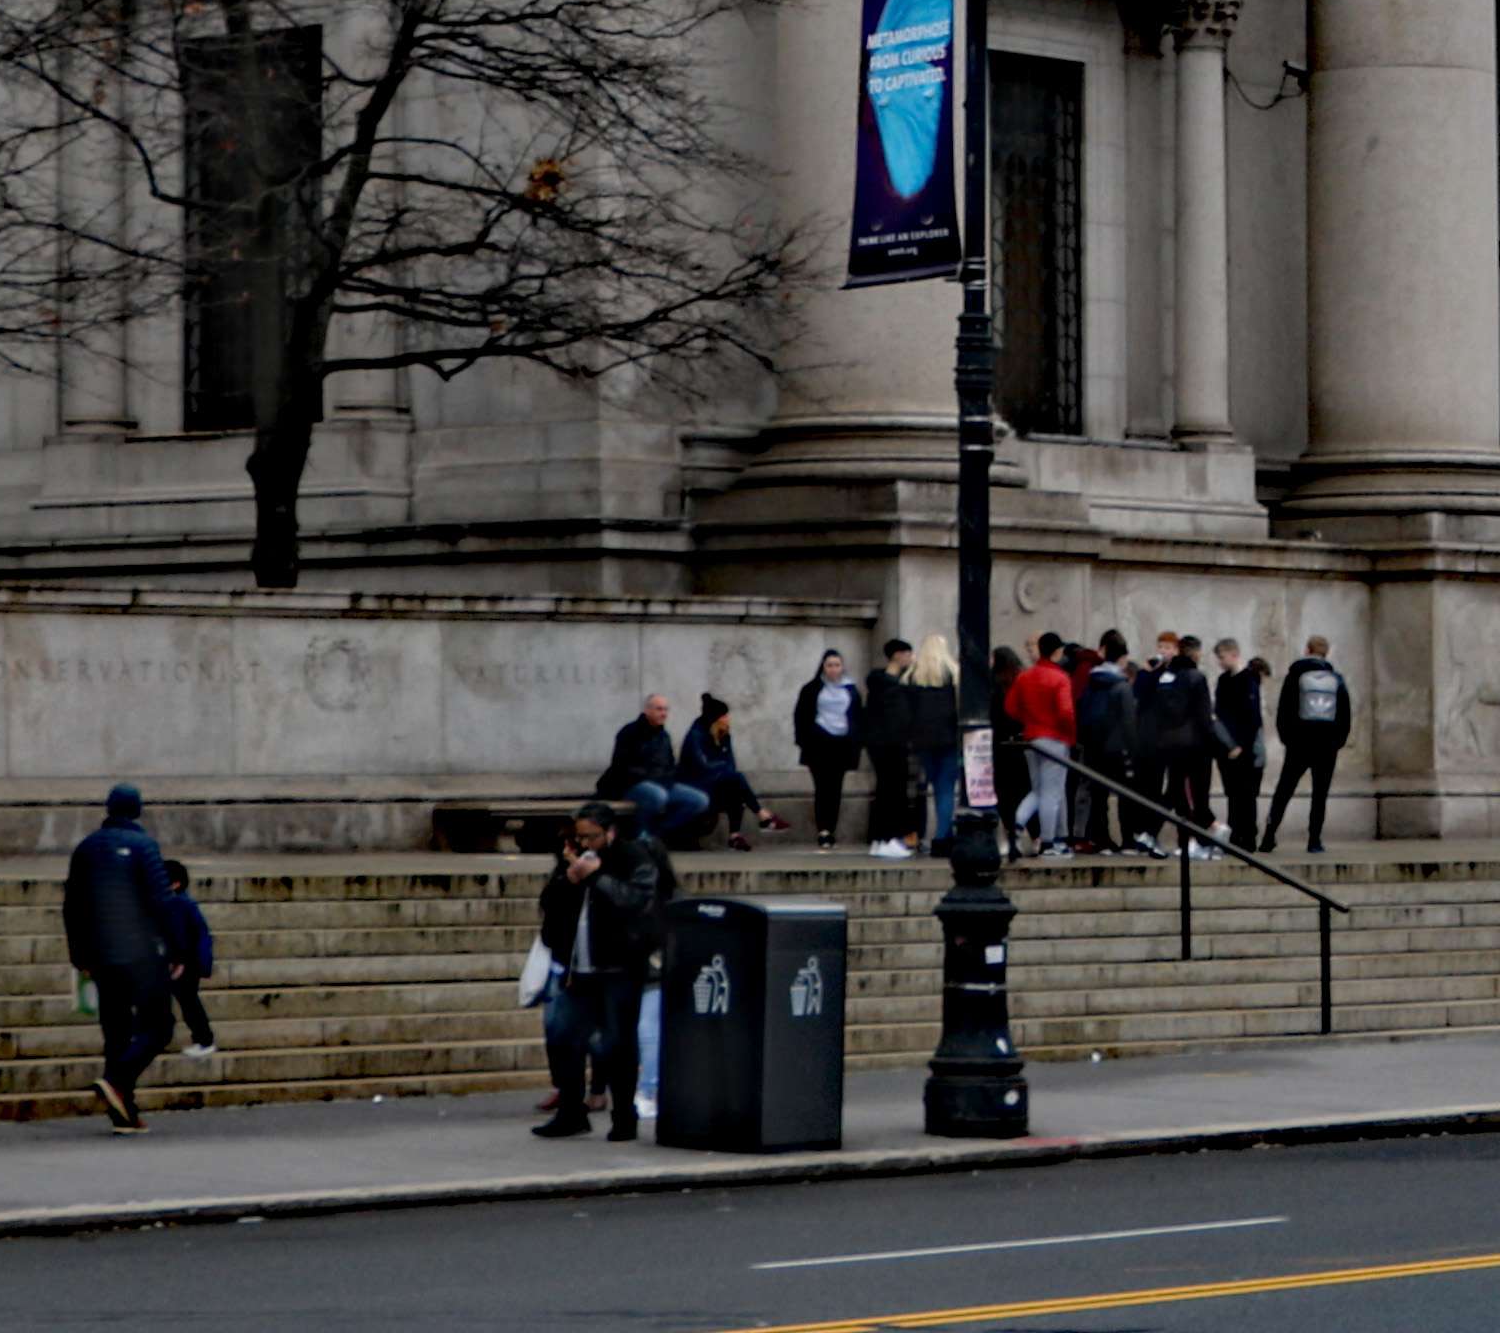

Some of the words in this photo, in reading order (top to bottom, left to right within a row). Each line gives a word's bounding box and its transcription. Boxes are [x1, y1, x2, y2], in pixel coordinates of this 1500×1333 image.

[869, 52, 900, 72] FROM
[900, 43, 947, 66] CURIOUS
[869, 77, 884, 94] TO
[451, 662, 634, 686] NATURALIST
